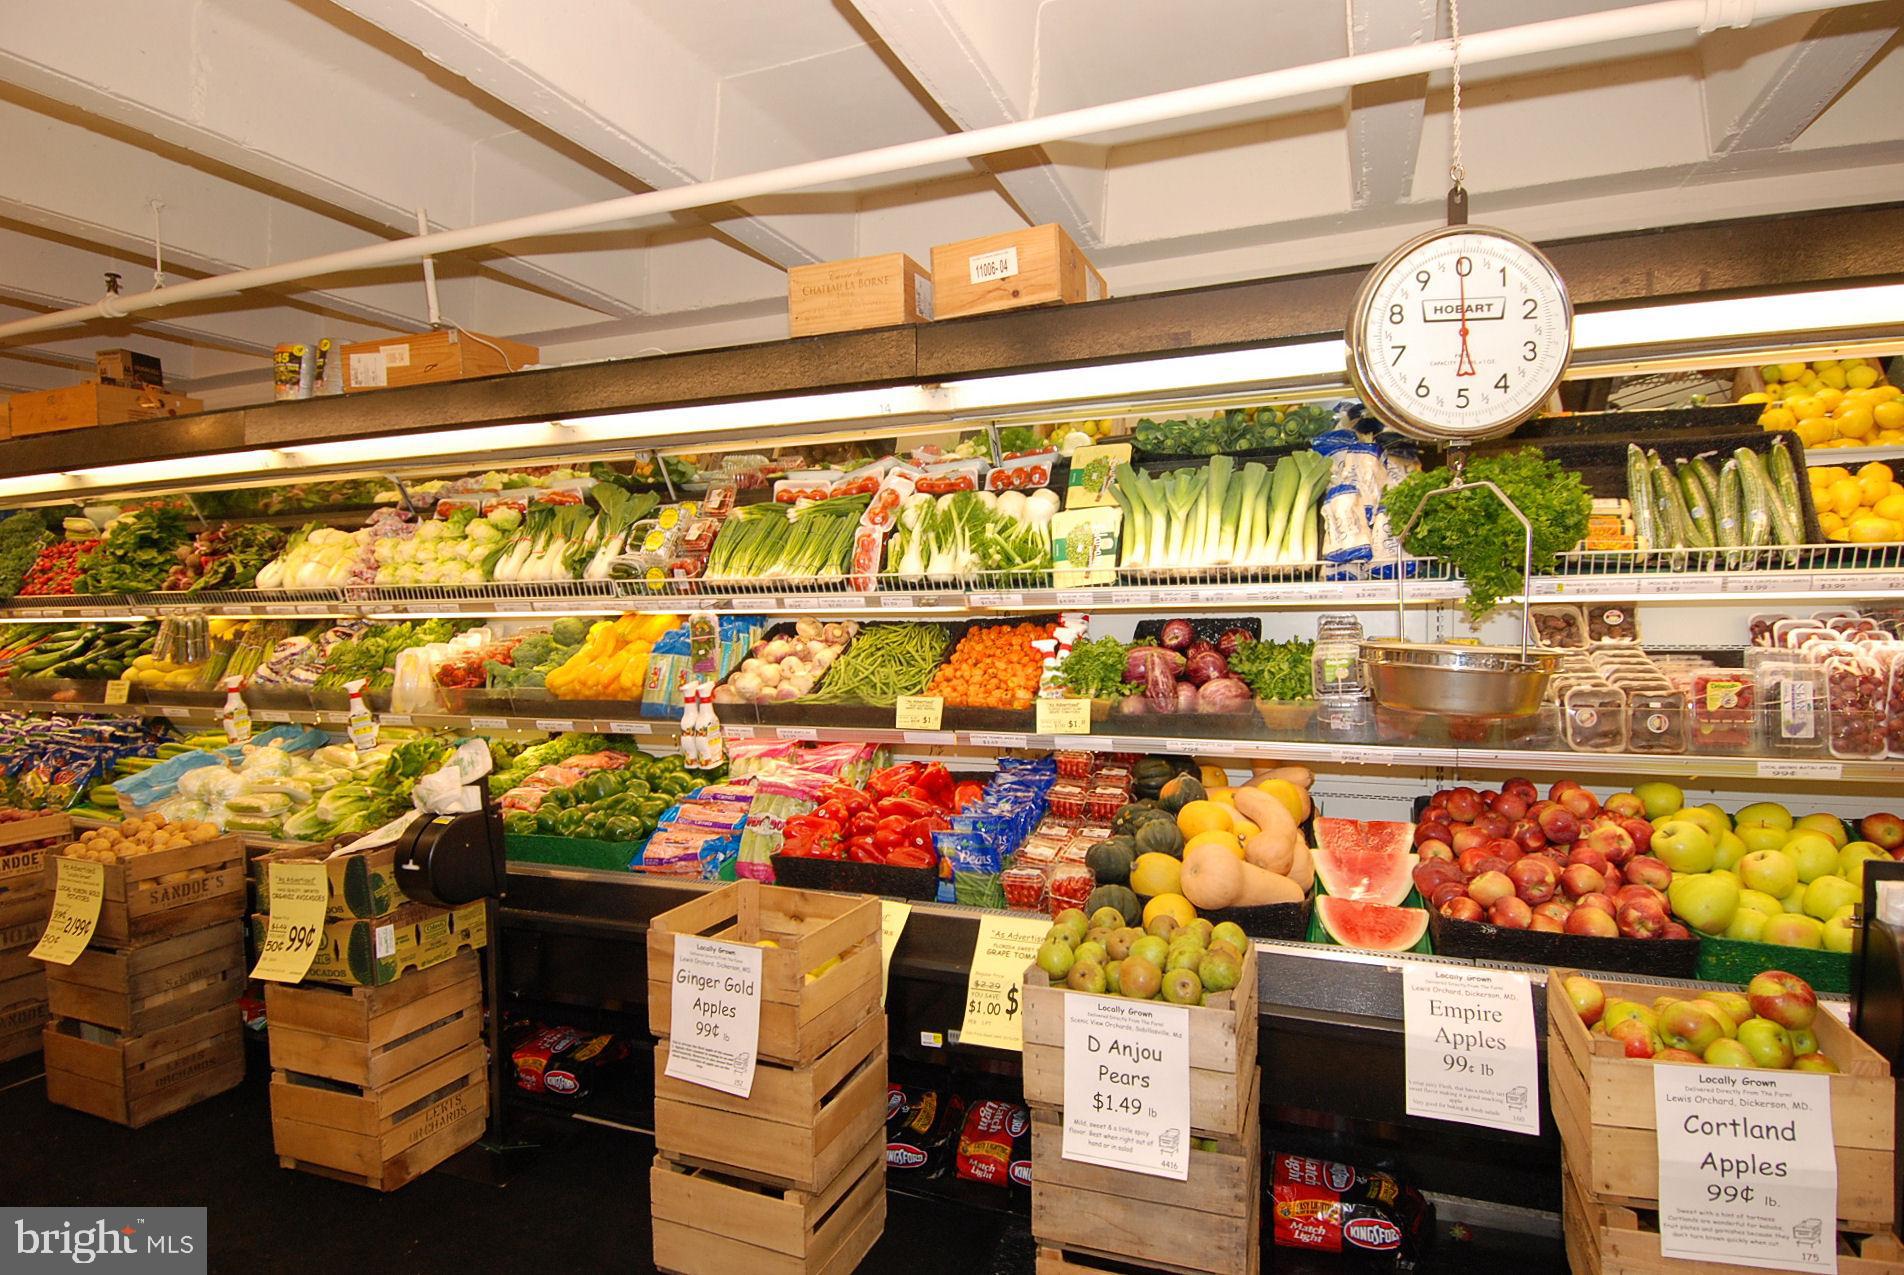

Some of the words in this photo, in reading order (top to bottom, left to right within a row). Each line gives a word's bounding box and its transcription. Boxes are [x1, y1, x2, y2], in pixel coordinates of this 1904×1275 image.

[1456, 257, 1472, 277] 0
[1499, 267, 1506, 287] 1
[858, 276, 888, 288] BORNE
[1416, 270, 1431, 291] 9
[1390, 304, 1404, 324] 8
[1433, 304, 1494, 314] HOBART
[1523, 299, 1538, 319] 2
[1391, 345, 1406, 367] 7
[1523, 341, 1537, 361] 3
[1415, 377, 1430, 398] 6
[1494, 373, 1510, 394] 4
[1456, 389, 1470, 408] 5
[63, 917, 91, 936] 2/99¢
[42, 934, 60, 944] 50¢
[265, 941, 284, 952] 50¢
[286, 925, 316, 952] 99¢
[697, 944, 716, 954] Locally
[718, 947, 736, 955] Grown
[986, 949, 1010, 958] GRAPE
[676, 969, 720, 991] Ginger
[724, 977, 754, 996] Gold
[693, 998, 736, 1018] Apples
[968, 1000, 1001, 1016] $1.00
[1098, 1004, 1125, 1015] Locally
[1128, 1008, 1153, 1018] Grown
[1430, 999, 1503, 1024] Empire
[696, 1021, 720, 1038] 99¢
[1434, 1027, 1507, 1051] Apples
[1087, 1035, 1100, 1053] D
[1108, 1039, 1163, 1063] Anjou
[1443, 1054, 1474, 1073] 99¢
[1481, 1064, 1494, 1077] lb
[1099, 1064, 1150, 1088] Pears
[1699, 1075, 1737, 1087] Locally
[1742, 1077, 1777, 1088] Grown
[1092, 1092, 1142, 1115] $1.49
[1148, 1107, 1157, 1118] lb
[1666, 1094, 1692, 1103] Lewis
[1695, 1096, 1736, 1107] Orchard,
[1740, 1098, 1789, 1110] Dickerson,
[1684, 1114, 1797, 1142] Cortland
[969, 1158, 995, 1172] Match
[970, 1167, 994, 1180] Light
[1161, 1160, 1178, 1169] 4416
[1700, 1152, 1788, 1179] Apples
[1707, 1183, 1754, 1203] 99¢
[1764, 1196, 1781, 1208] lb.
[1290, 1221, 1326, 1236] Match
[1293, 1229, 1324, 1244] Light
[1801, 1253, 1820, 1262] 175
